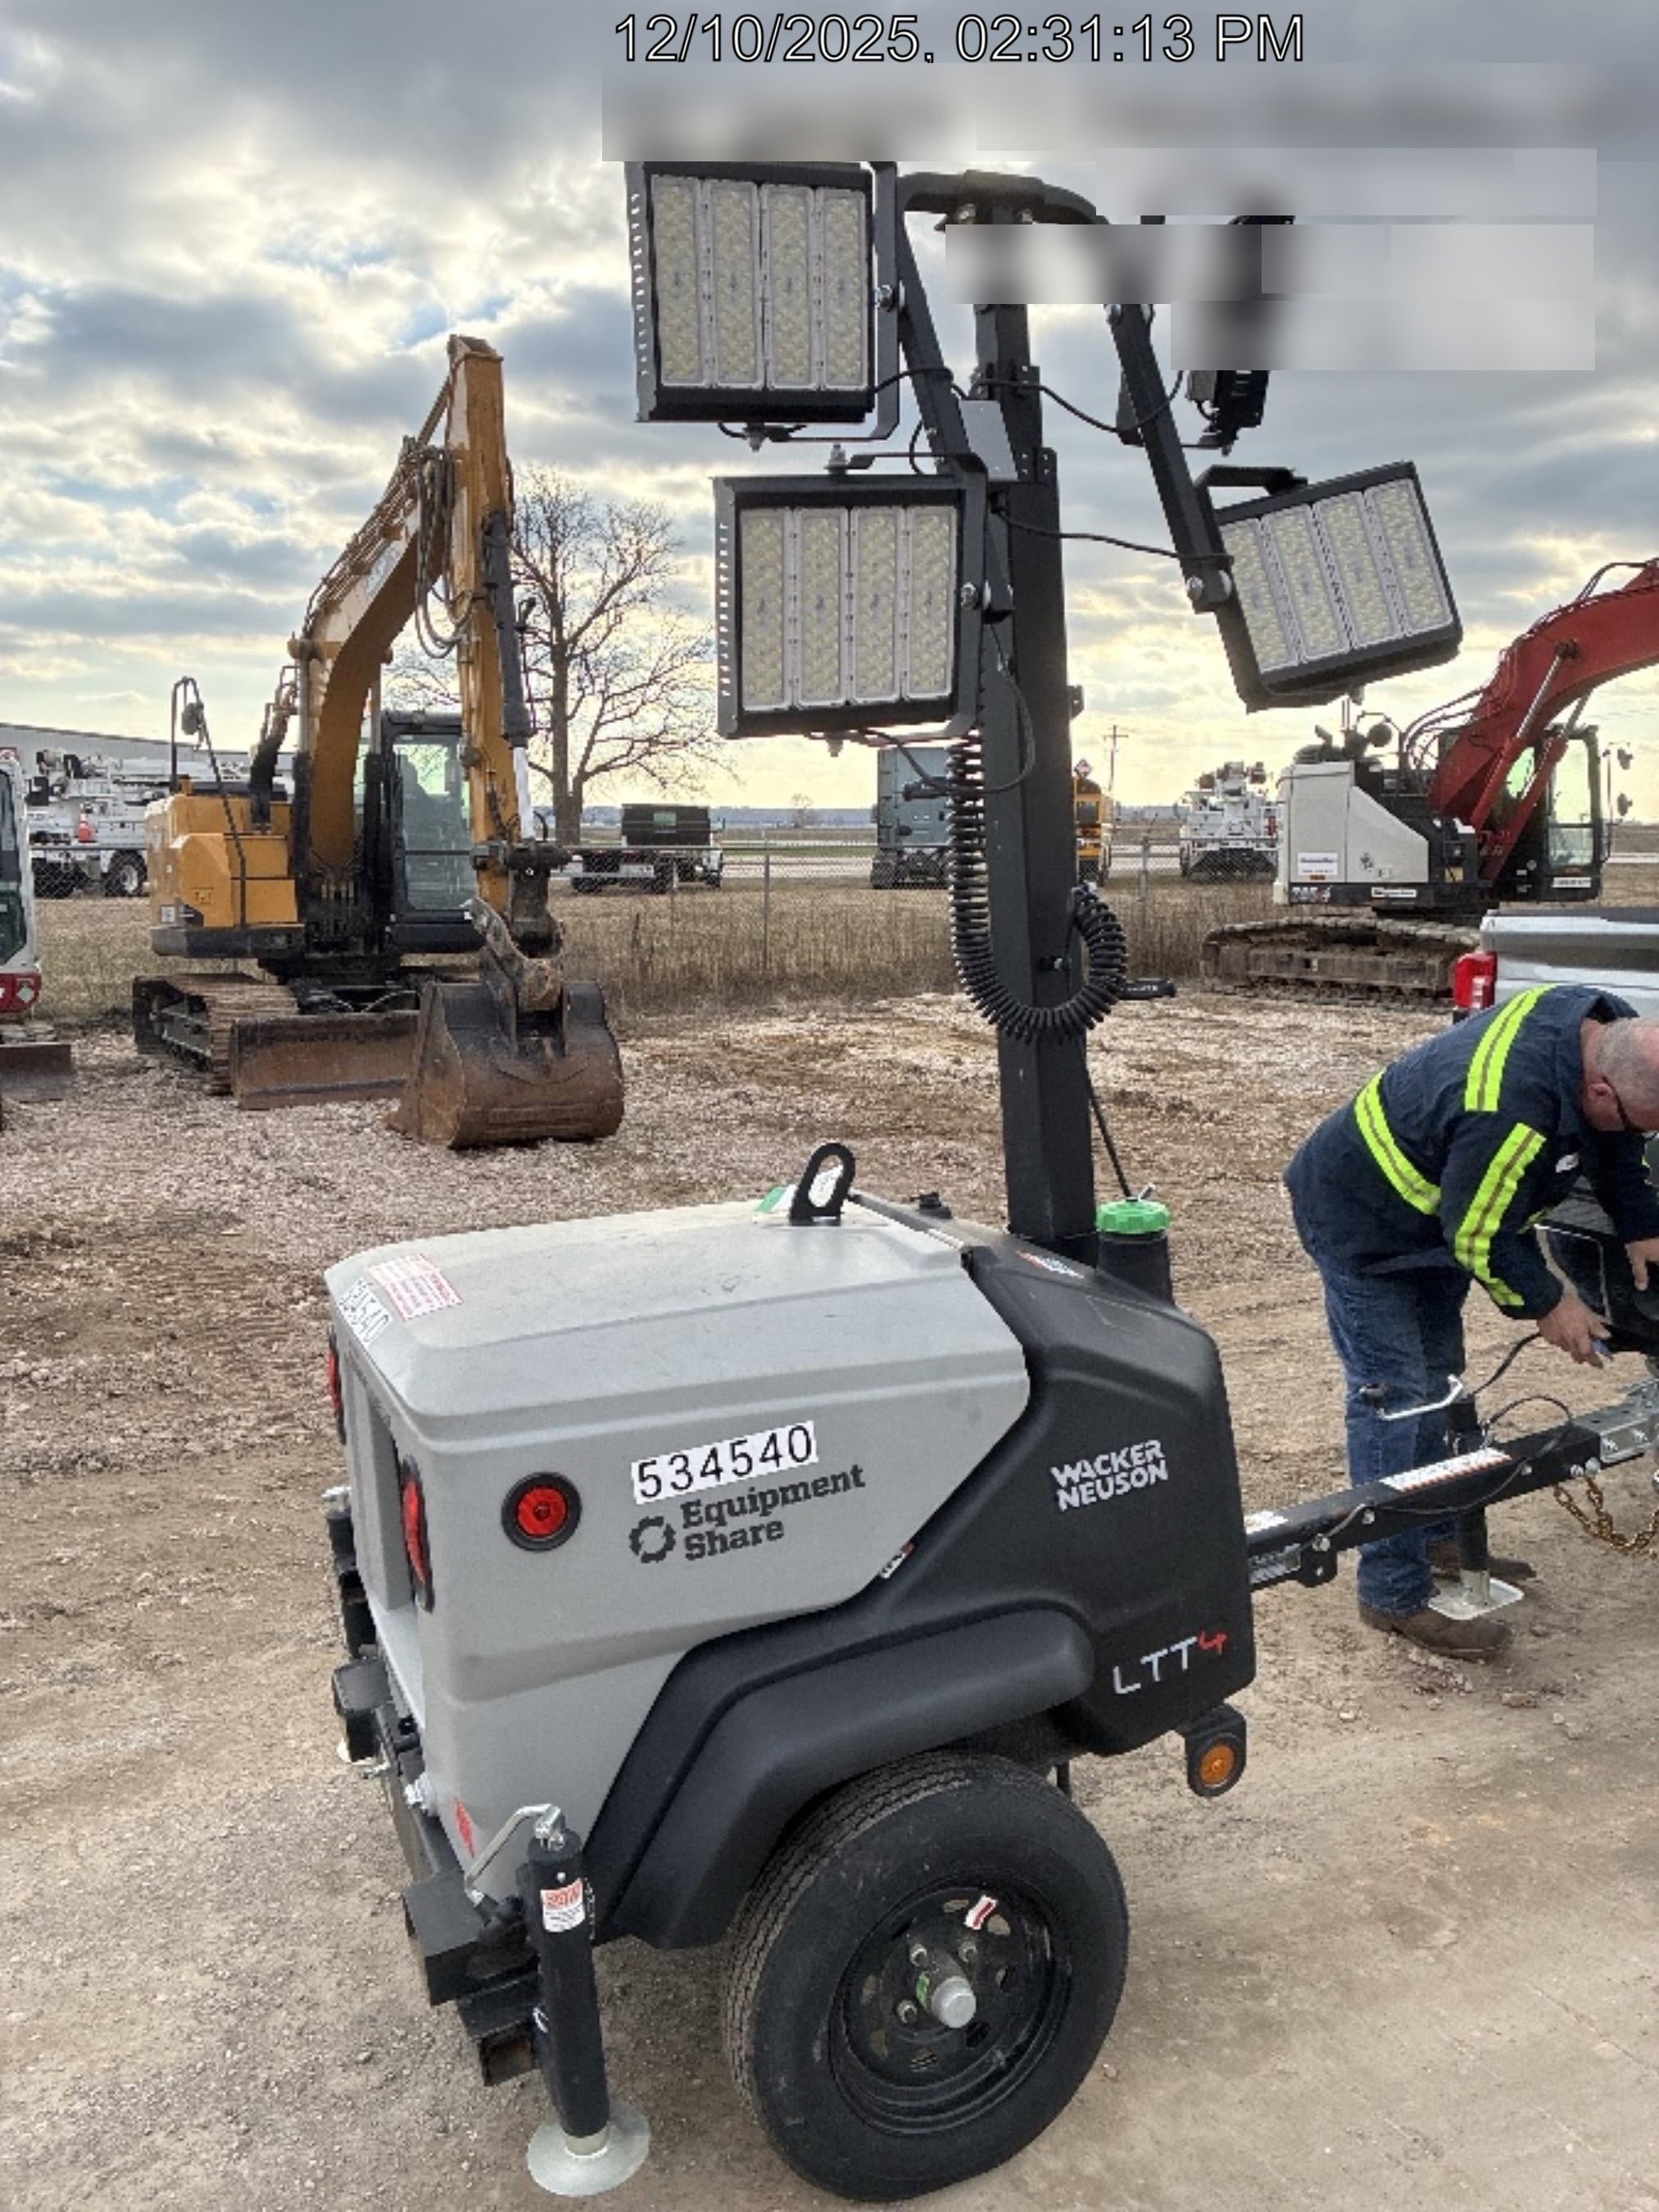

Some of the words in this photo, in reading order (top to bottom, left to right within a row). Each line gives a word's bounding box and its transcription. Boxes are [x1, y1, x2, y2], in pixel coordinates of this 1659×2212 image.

[637, 1424, 813, 1498] 534540
[1049, 1439, 1167, 1489] WACKER
[1055, 1459, 1169, 1512] NEUSON
[679, 1463, 867, 1530] Equipment
[683, 1520, 786, 1562] Share
